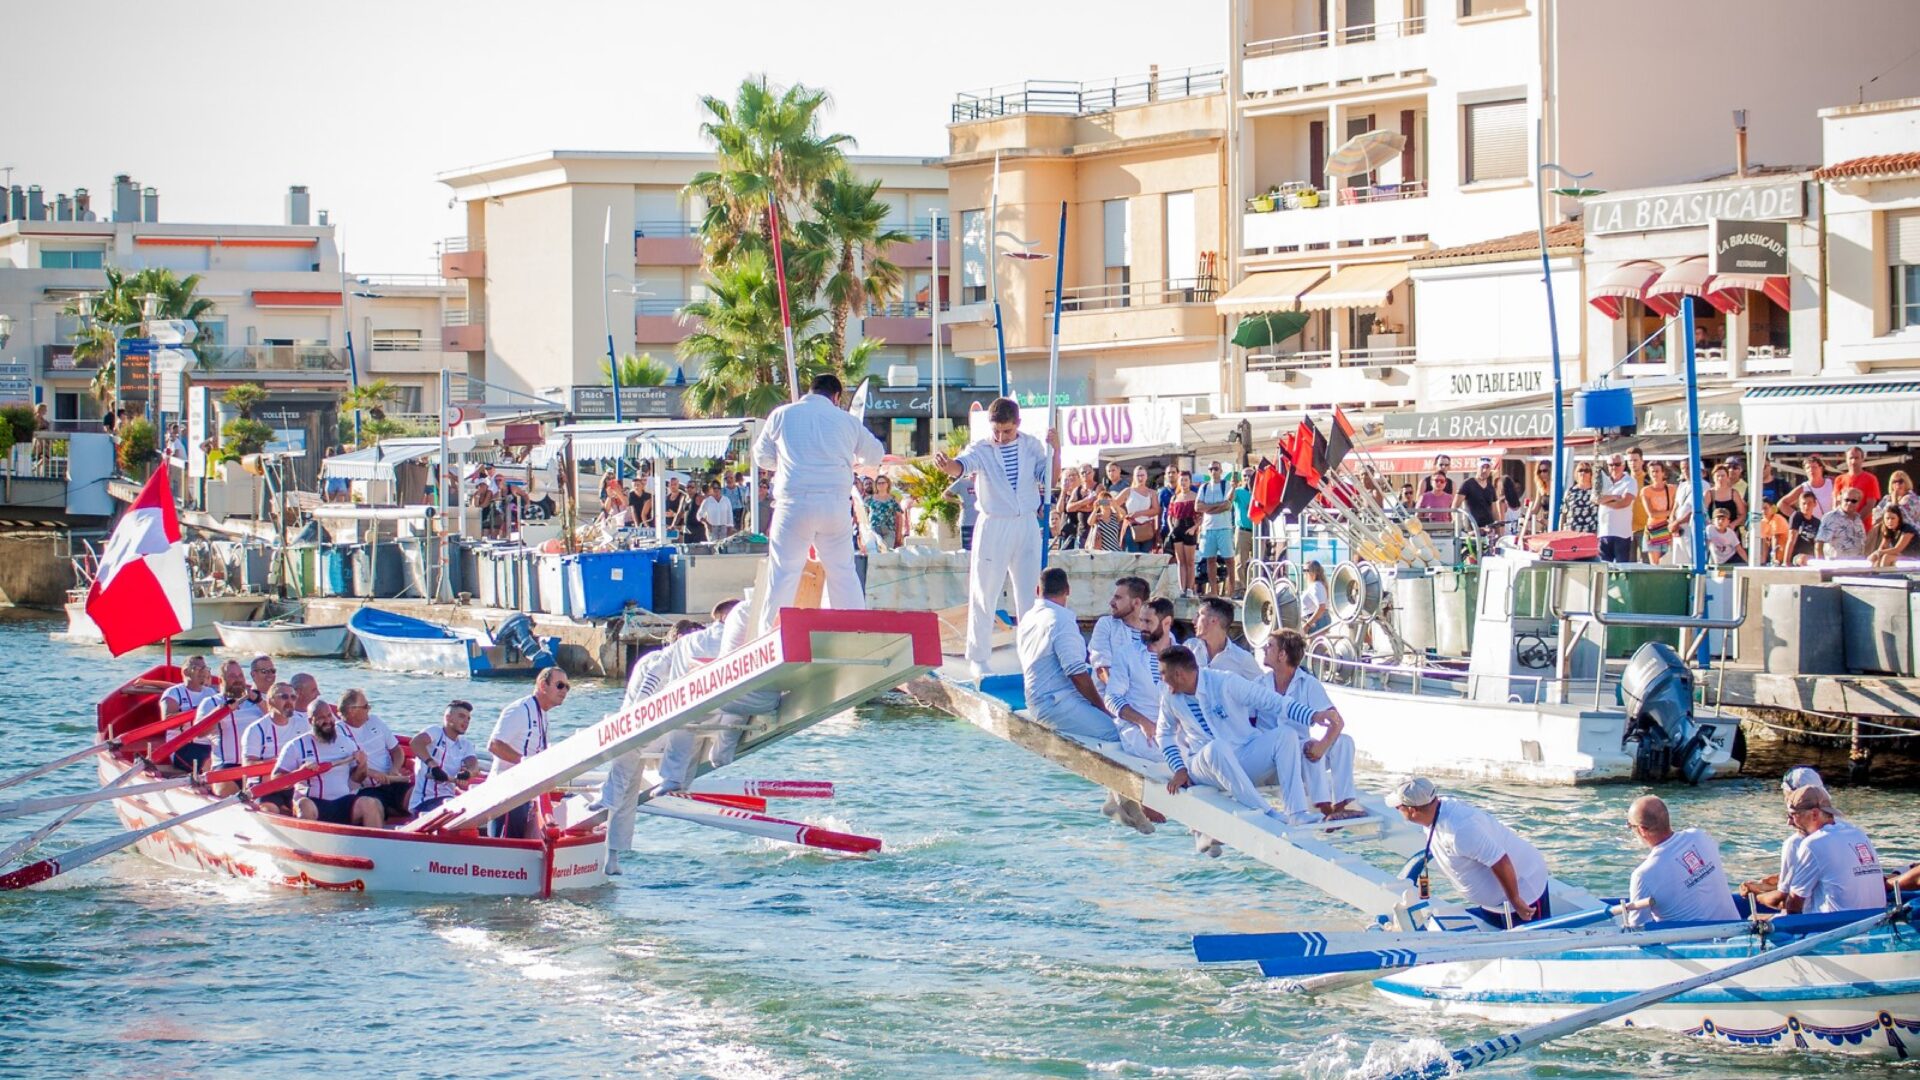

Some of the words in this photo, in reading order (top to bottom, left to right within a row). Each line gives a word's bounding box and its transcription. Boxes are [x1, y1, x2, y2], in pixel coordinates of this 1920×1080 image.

[1592, 203, 1624, 232] LA
[1635, 186, 1796, 228] BRASUCADE
[1717, 240, 1732, 254] LA
[1729, 233, 1787, 258] BRASUCADE
[1450, 373, 1472, 394] 300
[1476, 370, 1542, 393] TABLEAUX
[580, 390, 604, 399] Snack
[909, 397, 935, 413] Caf
[262, 411, 300, 419] TOILETTES
[1067, 405, 1133, 446] CASSUS
[1417, 416, 1440, 438] LA
[1449, 412, 1563, 437] BRASUCAD
[598, 711, 632, 747] LANCE
[634, 686, 686, 726] SPORTIVE
[688, 640, 776, 702] PALAVASIENNE
[429, 861, 468, 876] Marcel
[472, 865, 528, 880] Benezech
[573, 859, 599, 876] Benezech
